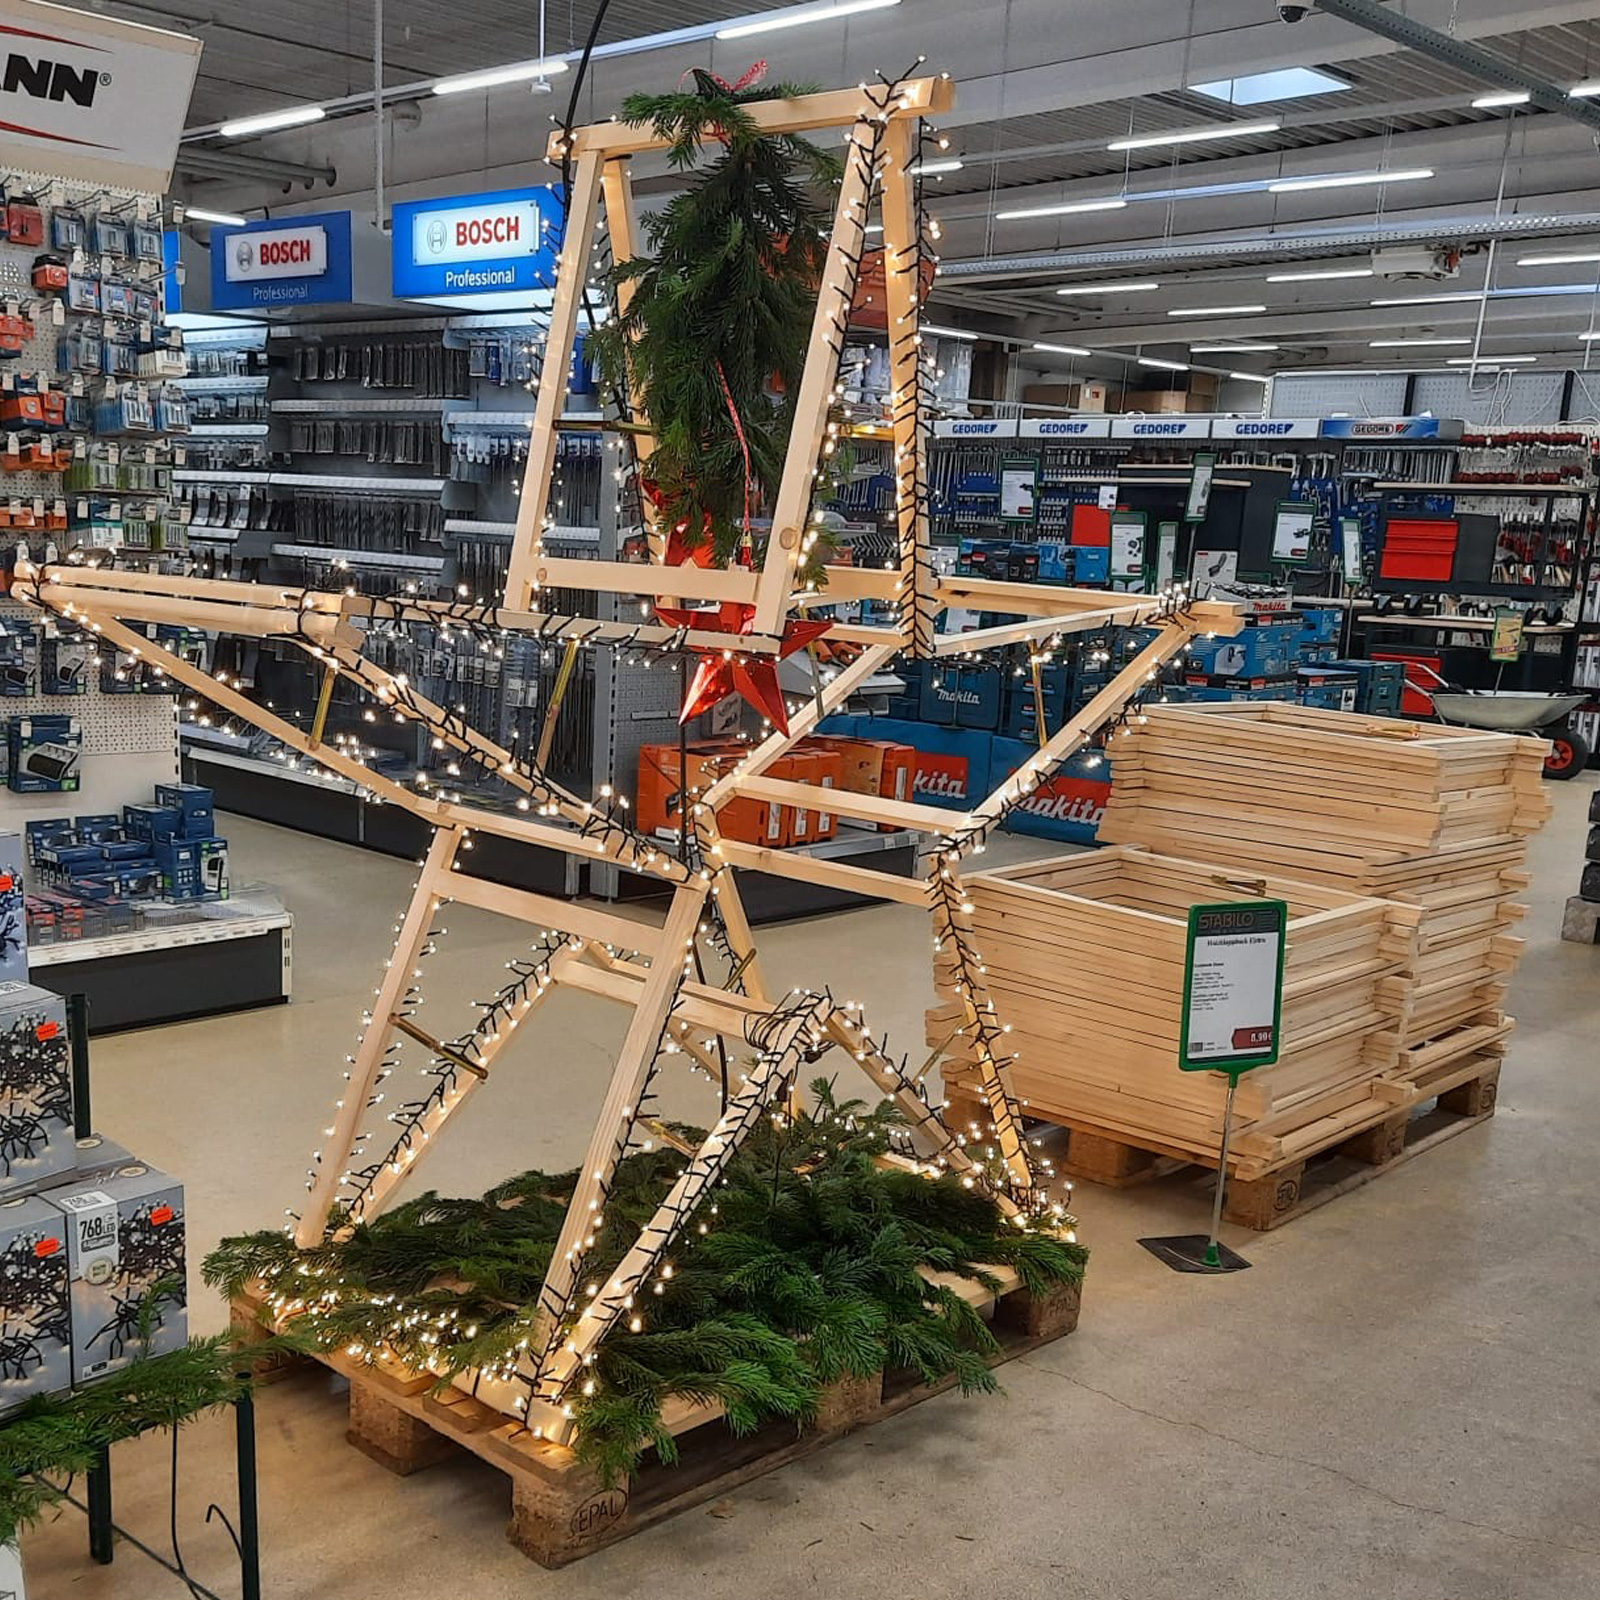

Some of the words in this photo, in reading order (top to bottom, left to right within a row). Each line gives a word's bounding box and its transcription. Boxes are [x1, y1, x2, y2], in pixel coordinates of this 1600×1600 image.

[0, 54, 98, 107] NN
[456, 216, 520, 246] BOSCH
[260, 240, 311, 266] BOSCH
[446, 266, 515, 287] Professional
[253, 283, 308, 301] Professional
[952, 423, 991, 434] GEDORE
[1039, 423, 1082, 434] GEDORE
[1133, 423, 1179, 435] GEDORE
[1235, 423, 1286, 435] GEDORE
[913, 769, 967, 800] kita
[1198, 911, 1254, 929] STABILO
[79, 1217, 102, 1240] 768
[578, 1495, 619, 1532] EPAL
